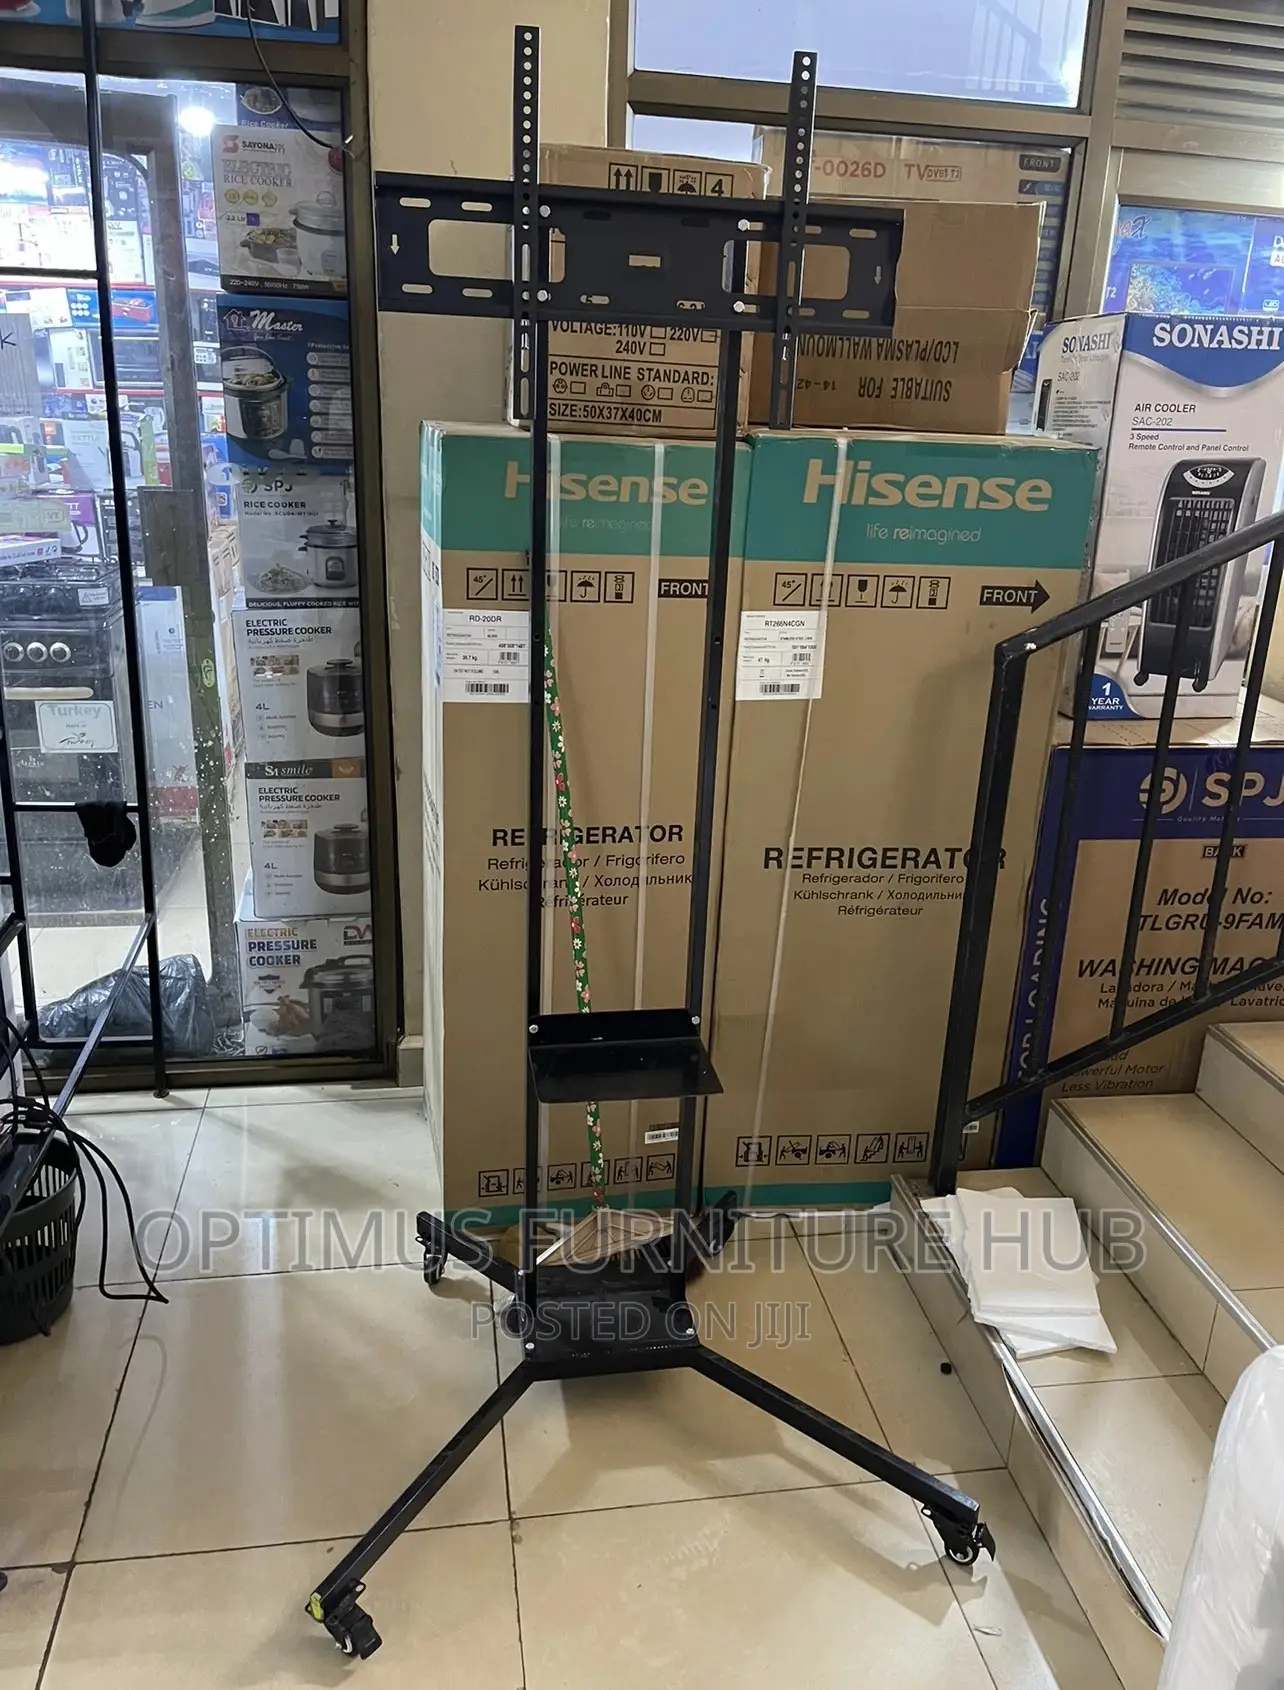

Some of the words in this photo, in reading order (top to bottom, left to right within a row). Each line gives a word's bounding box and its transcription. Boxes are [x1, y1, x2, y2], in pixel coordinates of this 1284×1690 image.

[241, 140, 275, 150] SAYONA
[1023, 159, 1055, 169] FRONT
[904, 163, 928, 180] TV
[223, 175, 248, 185] RICE
[250, 176, 292, 188] COOKER
[249, 309, 304, 332] Master
[669, 327, 700, 342] 220V
[1152, 322, 1283, 350] SONASHI
[615, 340, 647, 355] 240V
[877, 338, 960, 364] LCD/PLASMA
[549, 361, 599, 378] POWER
[601, 365, 632, 380] LINE
[636, 367, 714, 386] STANDARD:
[858, 376, 884, 399] FOR
[890, 376, 953, 402] SUITABLE
[549, 403, 662, 423] SIZE:50X37X40CM
[1134, 403, 1152, 413] AIR
[1154, 403, 1196, 414] COOLER
[1131, 416, 1173, 427] SAC-202
[1136, 433, 1159, 441] Speed
[1128, 443, 1157, 451] Remote
[1158, 443, 1185, 451] Control
[1223, 444, 1250, 452] Control
[803, 458, 1053, 512] Hisense
[243, 501, 266, 509] RICE
[268, 501, 307, 509] COOKER
[866, 523, 889, 540] life
[893, 527, 982, 546] reimagined
[660, 583, 708, 597] FRONT
[983, 589, 1039, 604] FRONT
[245, 618, 288, 628] ELECTRIC
[246, 627, 294, 637] PRESSURE
[294, 626, 333, 636] COOKER
[1102, 682, 1112, 696] 1
[255, 703, 270, 711] 4L
[1091, 697, 1120, 705] YEAR
[48, 704, 101, 719] Turkey
[280, 764, 314, 776] smile
[258, 786, 299, 795] ELECTRIC
[258, 794, 304, 803] PRESSURE
[304, 793, 341, 802] COOKER
[1177, 815, 1207, 823] Quality
[264, 862, 278, 870] 4L
[801, 873, 885, 886] Refrigerador
[887, 873, 895, 884] /
[897, 873, 965, 886] Frigorifero
[793, 889, 874, 900] Kühlschrank
[887, 889, 964, 902] Холодильни
[1232, 887, 1273, 905] No:
[838, 905, 924, 917] Réfrigérateur
[247, 928, 299, 938] ELECTRIC
[248, 939, 318, 952] PRESSURE
[249, 954, 301, 967] COOKER
[1078, 957, 1200, 978] WAHING
[1125, 1064, 1165, 1075] Motor
[1061, 1081, 1092, 1093] Less
[1095, 1079, 1154, 1091] Vibration
